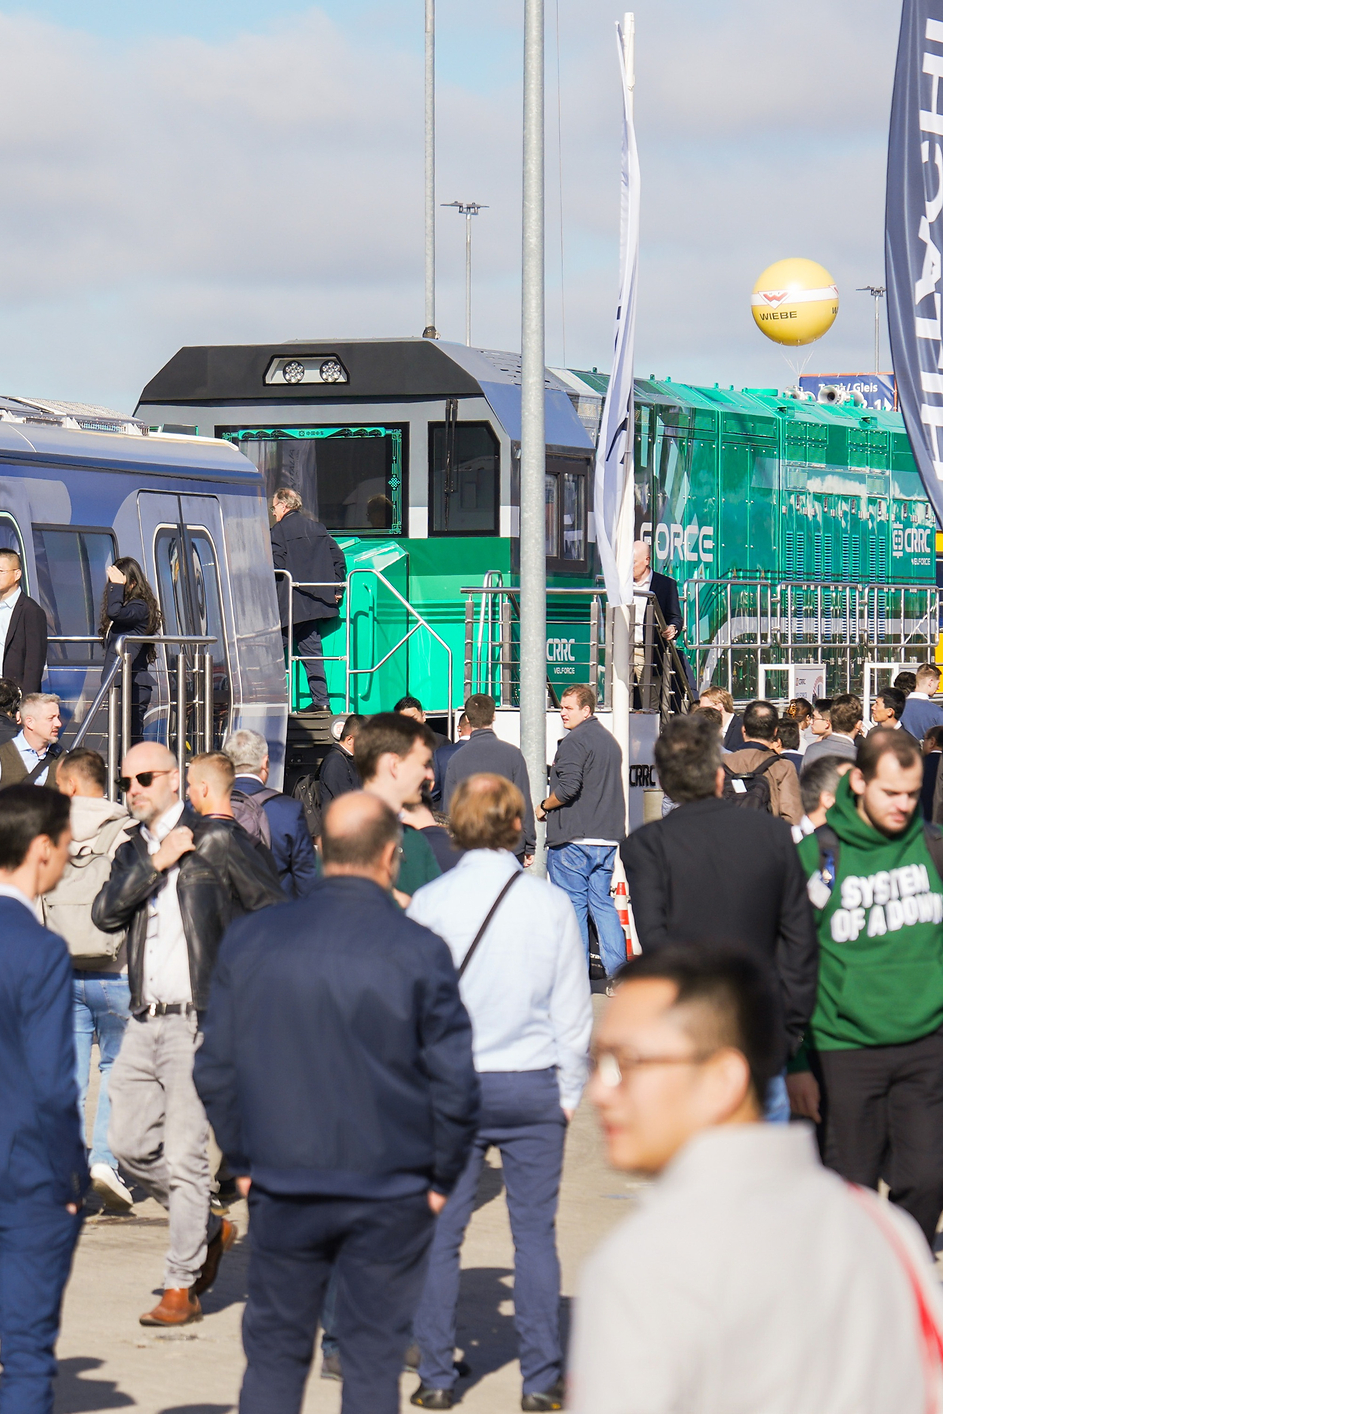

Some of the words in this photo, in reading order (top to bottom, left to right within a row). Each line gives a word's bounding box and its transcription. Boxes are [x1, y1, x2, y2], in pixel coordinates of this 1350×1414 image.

[759, 311, 798, 321] WIEBE
[852, 382, 878, 393] Gleis
[904, 528, 931, 553] CRRC
[546, 637, 576, 661] CRRC
[553, 667, 575, 675] VELFORCE
[629, 764, 656, 787] CRRC
[840, 863, 930, 910] SYSTEM
[830, 907, 866, 943] OF
[867, 904, 888, 938] A
